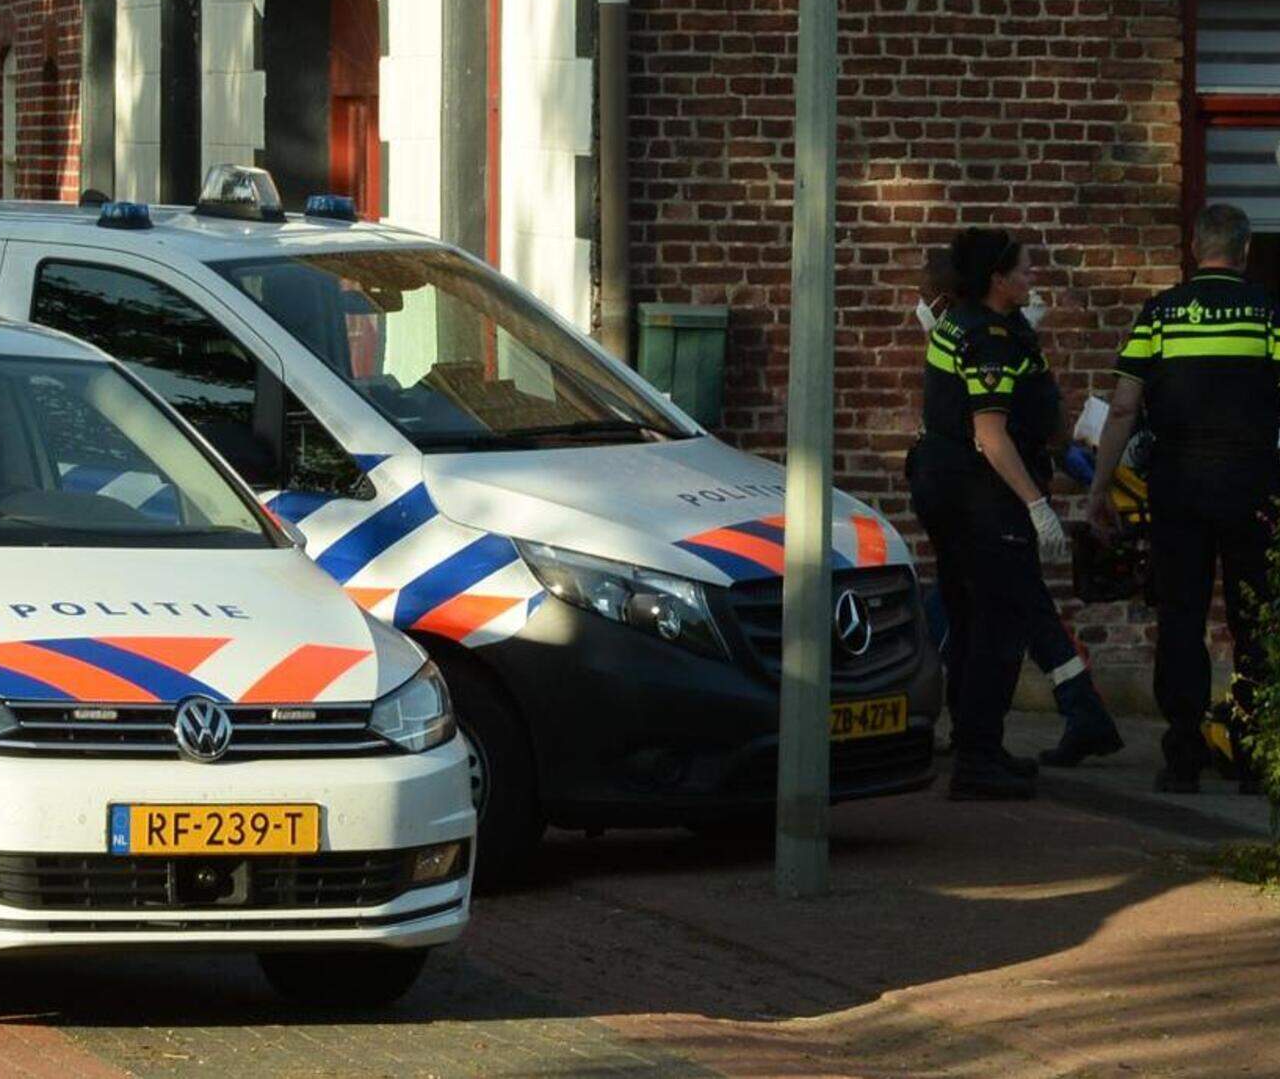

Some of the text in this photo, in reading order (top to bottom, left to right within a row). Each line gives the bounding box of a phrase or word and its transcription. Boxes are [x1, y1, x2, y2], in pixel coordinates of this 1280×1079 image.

[1177, 304, 1253, 322] POLITIE
[9, 601, 251, 619] POLITIE
[112, 812, 303, 846] NL RF-239-T
